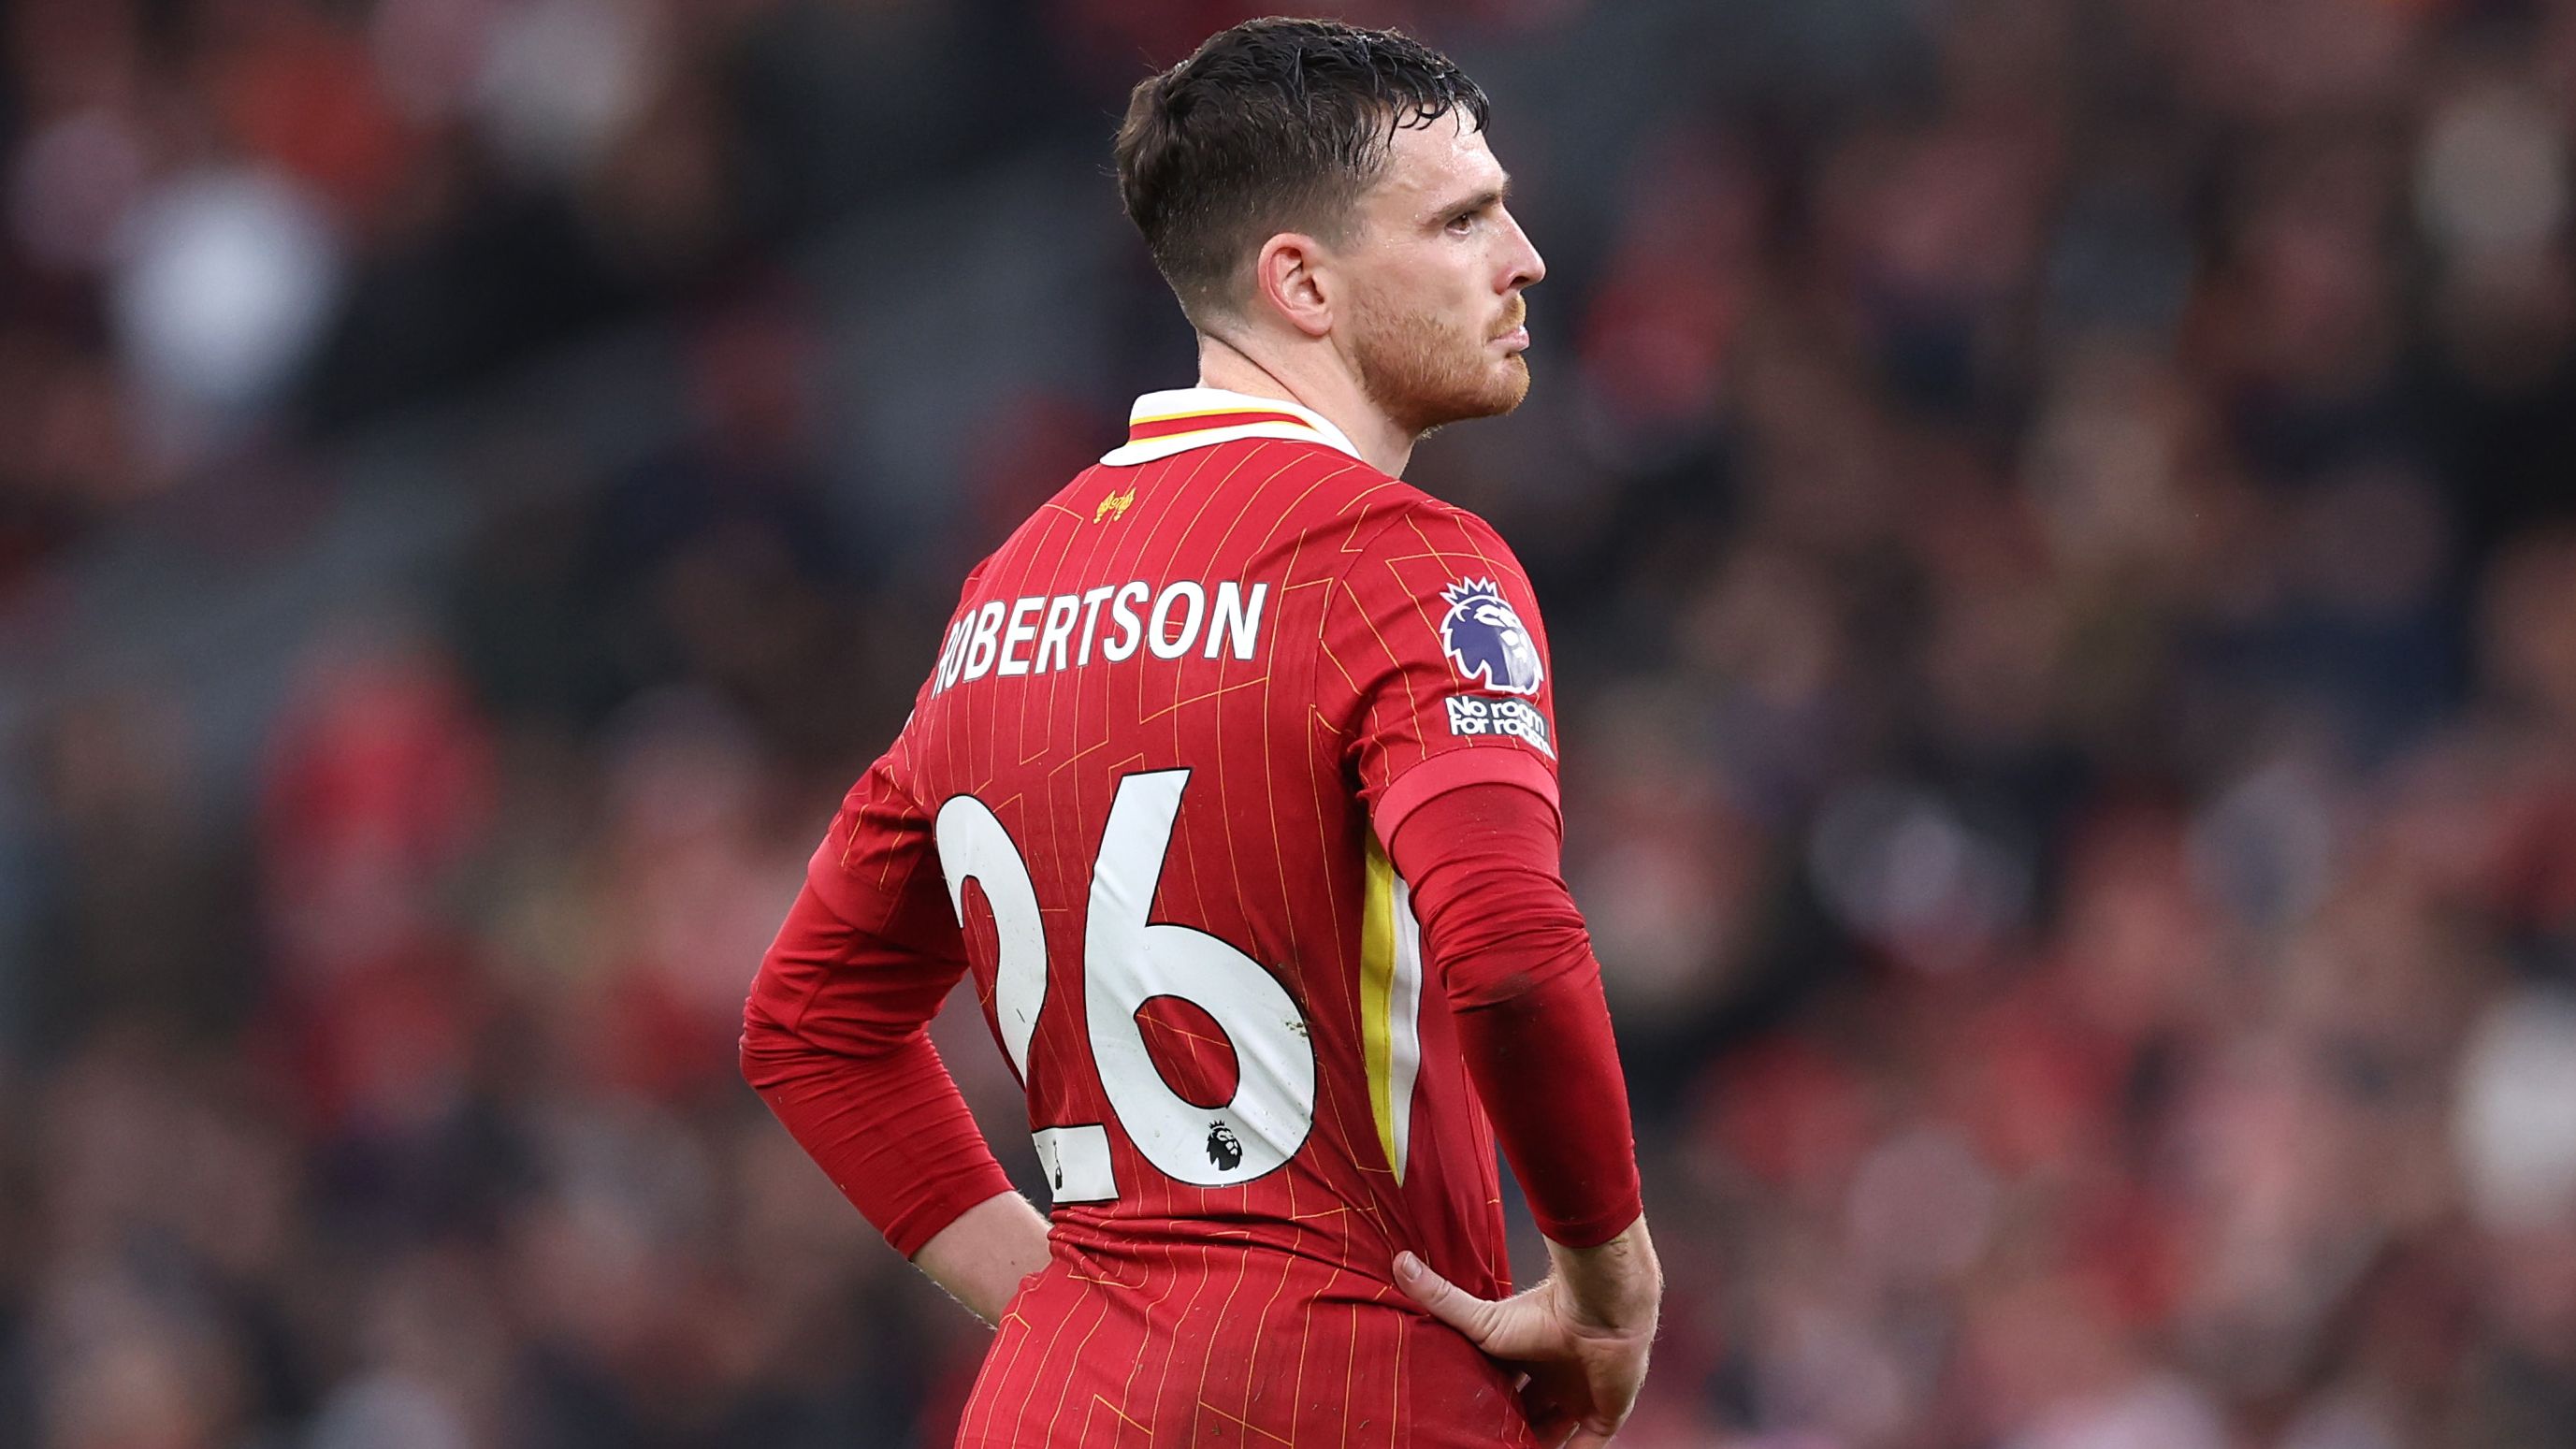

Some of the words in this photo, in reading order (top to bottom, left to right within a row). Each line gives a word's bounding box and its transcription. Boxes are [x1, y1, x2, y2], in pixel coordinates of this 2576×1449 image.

[931, 580, 1267, 700] ROBERTSON
[1445, 695, 1487, 717] No
[1490, 701, 1544, 737] room
[1450, 714, 1489, 735] For
[935, 767, 1316, 1204] 26
